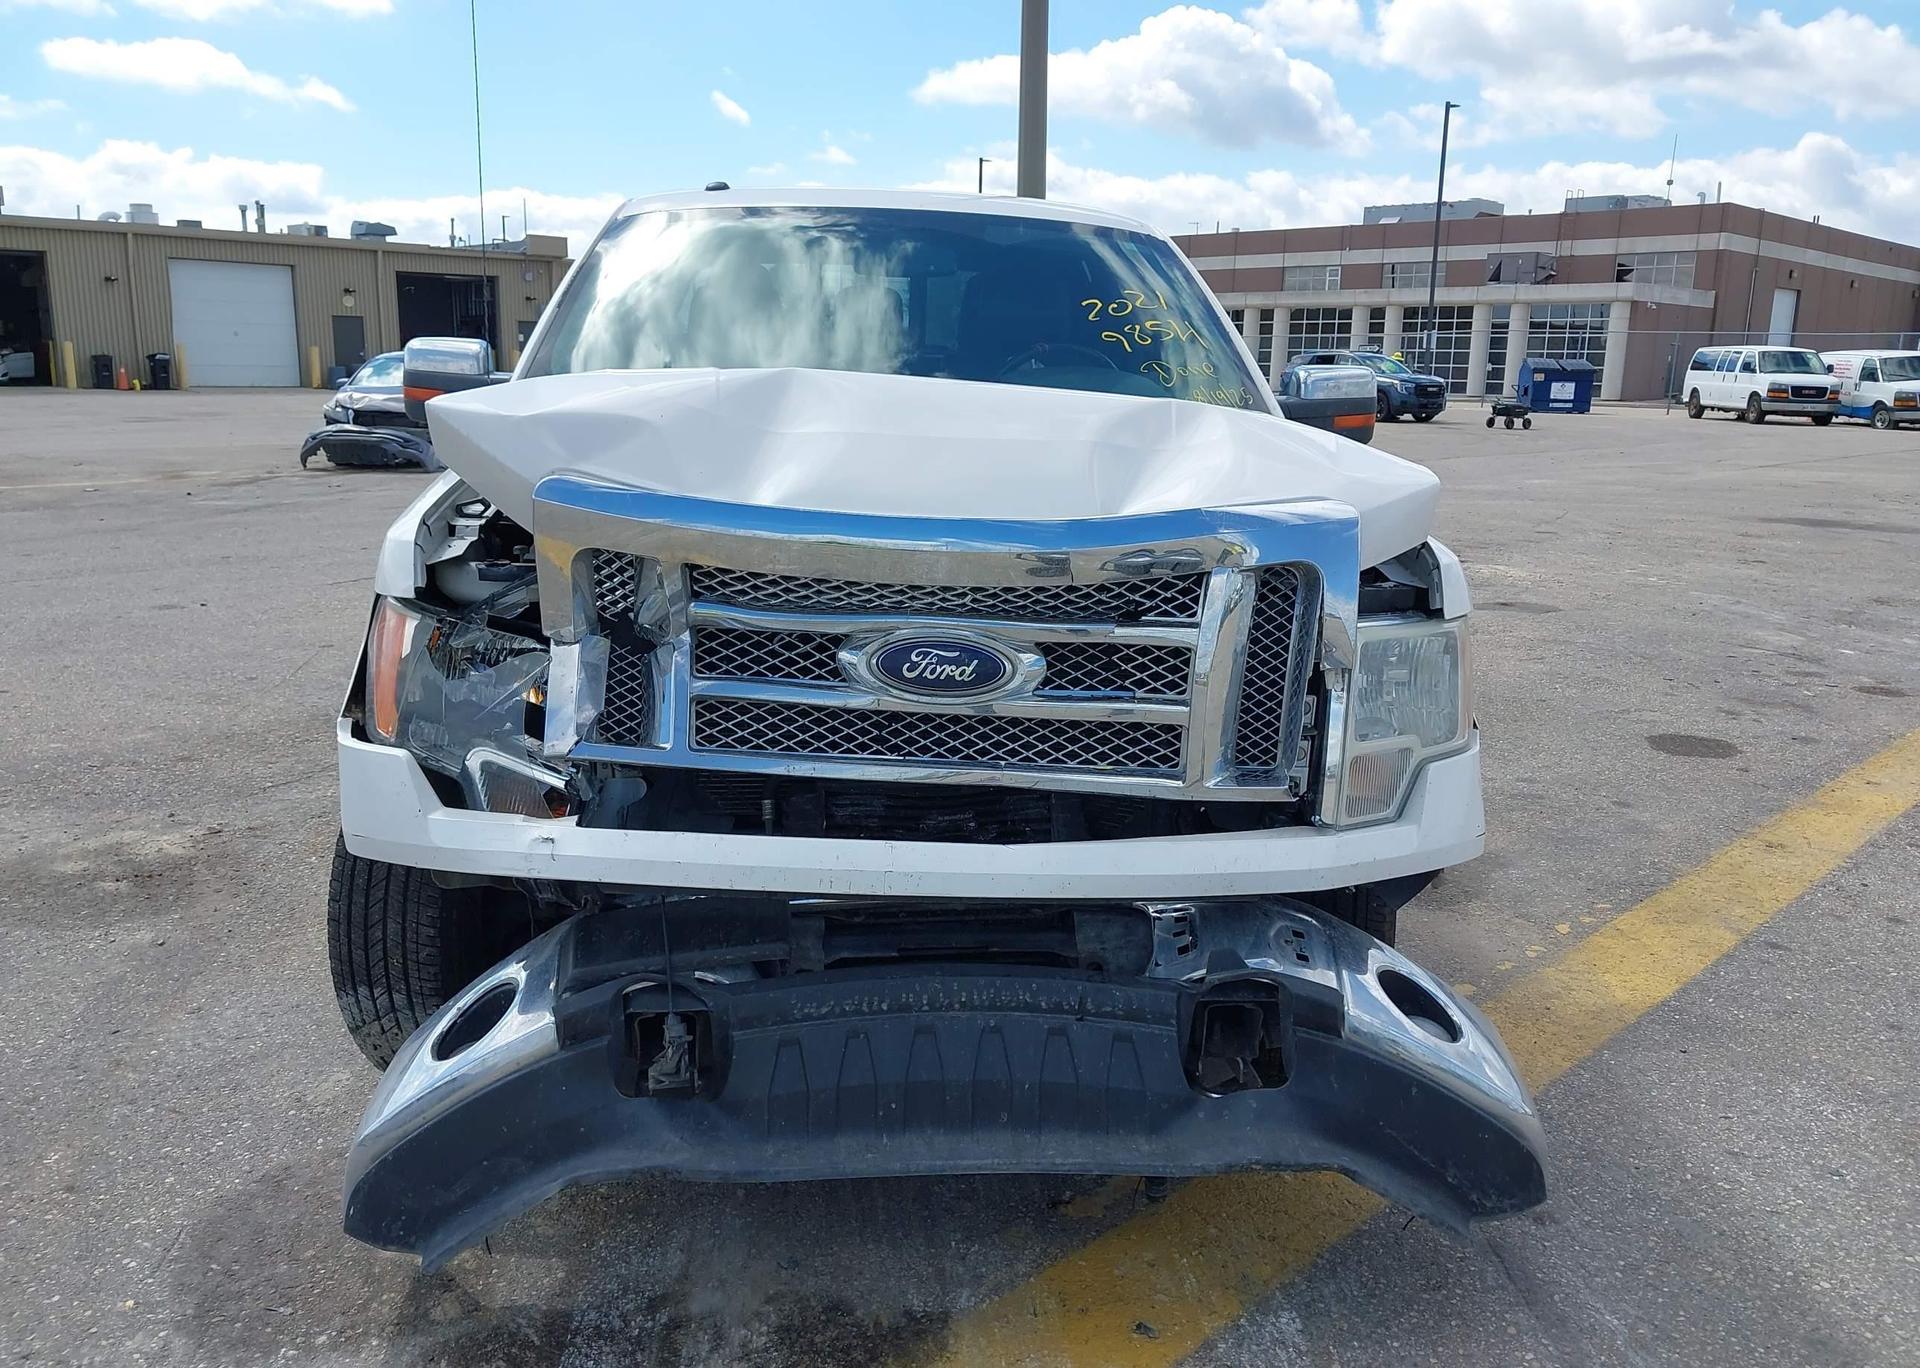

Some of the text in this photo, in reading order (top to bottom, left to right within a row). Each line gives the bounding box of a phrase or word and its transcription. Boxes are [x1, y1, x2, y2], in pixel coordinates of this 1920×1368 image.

[1081, 290, 1168, 321] 2021
[1140, 360, 1219, 388] Done
[902, 647, 979, 682] Ford
